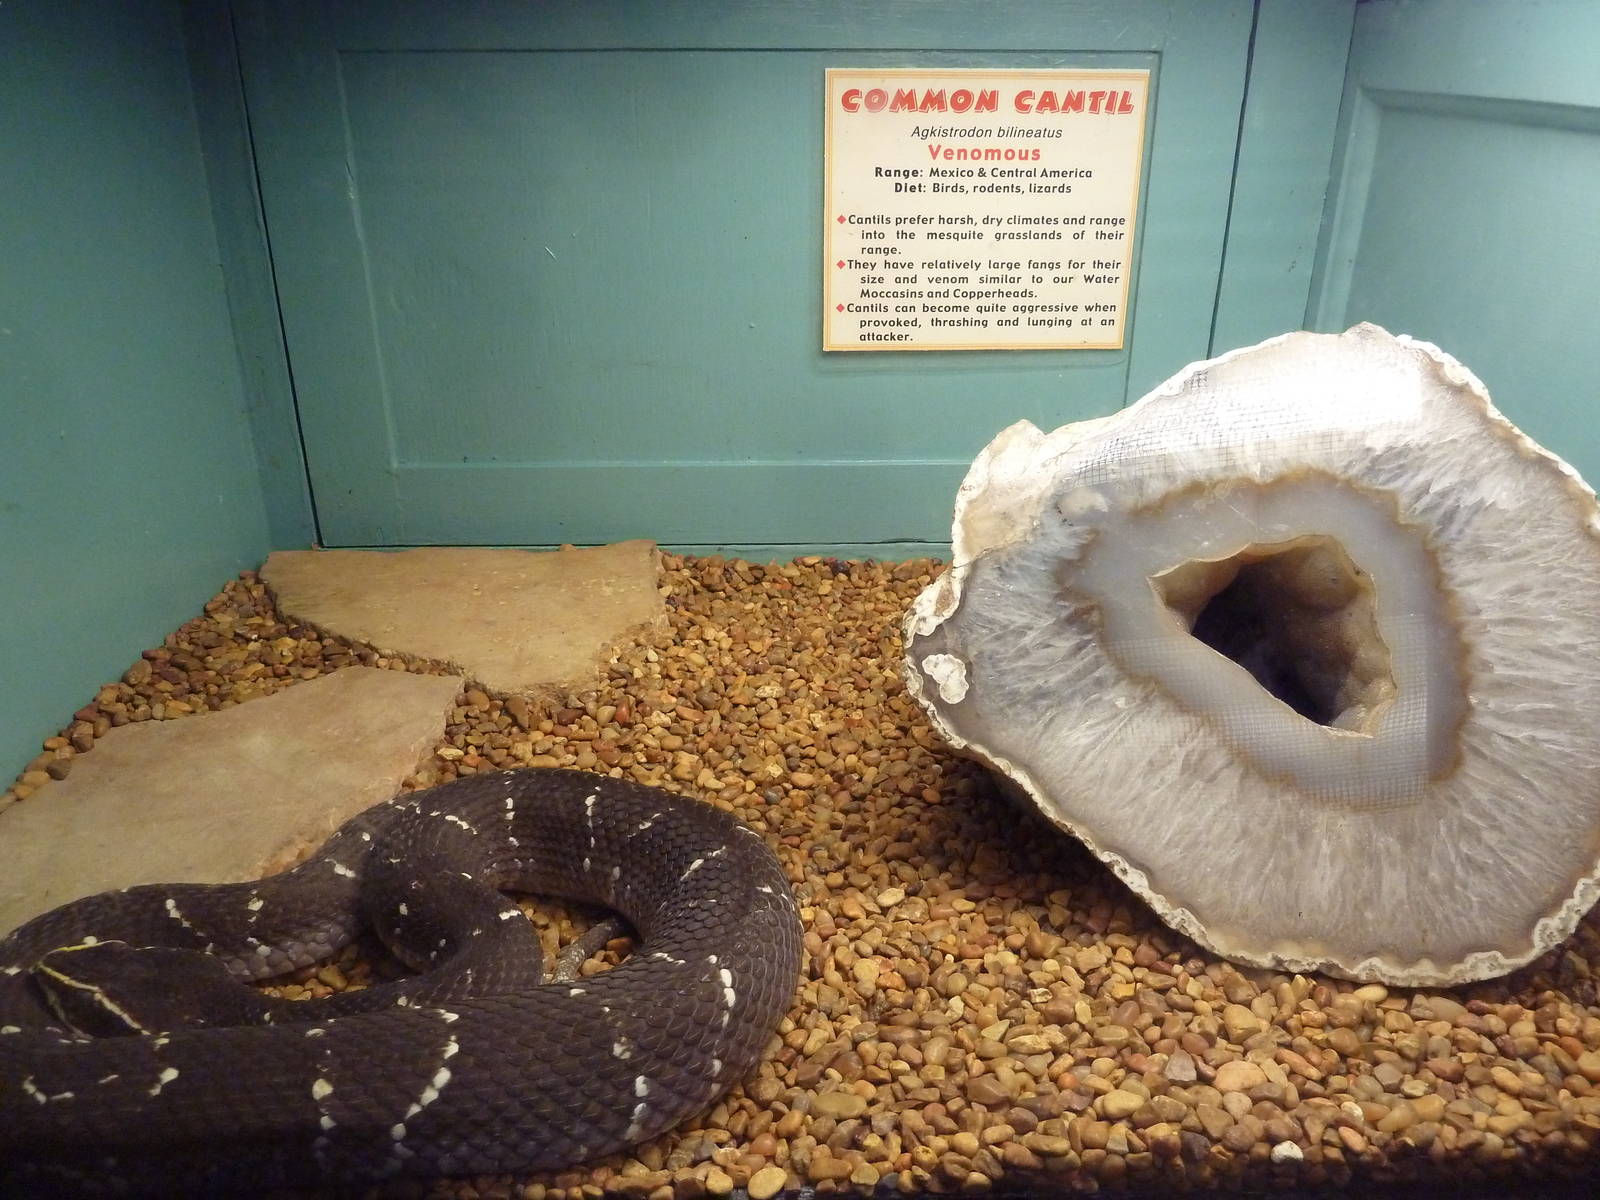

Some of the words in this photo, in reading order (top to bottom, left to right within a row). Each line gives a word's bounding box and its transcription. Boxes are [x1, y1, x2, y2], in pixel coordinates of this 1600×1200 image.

[841, 88, 999, 113] COMMON
[1014, 90, 1134, 115] CANTIL
[910, 126, 992, 140] Agkistrodon
[997, 126, 1062, 138] bilineatus
[928, 144, 1040, 160] Venomous
[875, 167, 923, 179] Range:
[929, 167, 974, 177] Mexico
[978, 167, 987, 177] &
[991, 168, 1036, 177] Central
[1040, 168, 1092, 178] America
[895, 183, 926, 193] Diet:
[933, 183, 968, 194] Birds,
[973, 183, 1024, 195] rodents,
[1029, 183, 1071, 193] lizards
[848, 215, 891, 224] Cantils
[895, 215, 934, 226] prefer
[939, 215, 977, 226] harsh,
[982, 215, 1002, 226] dry
[1007, 215, 1059, 225] climates
[1063, 215, 1085, 225] and
[1090, 218, 1125, 227] range
[862, 230, 885, 239] into
[896, 230, 915, 239] the
[927, 230, 983, 241] mesquite
[995, 230, 1062, 241] grasslands
[1073, 230, 1085, 240] of
[1096, 230, 1124, 240] their
[861, 247, 901, 256] range.
[847, 260, 876, 271] They
[884, 260, 914, 269] have
[922, 260, 981, 271] relatively
[989, 260, 1020, 271] large
[1028, 260, 1061, 271] fangs
[1068, 260, 1085, 269] for
[1093, 260, 1121, 269] their
[860, 275, 884, 284] size
[895, 274, 917, 284] and
[928, 276, 968, 285] venom
[979, 274, 1022, 284] similar
[1032, 274, 1043, 284] to
[1053, 275, 1074, 284] our
[1084, 274, 1120, 284] Water
[860, 288, 923, 298] Moccasins
[927, 289, 949, 298] and
[953, 289, 1037, 300] Copperheads.
[847, 303, 888, 312] Cantils
[895, 305, 915, 313] can
[923, 303, 969, 312] become
[976, 303, 1006, 314] quite
[1013, 303, 1078, 314] aggressive
[1085, 303, 1116, 312] when
[860, 317, 921, 328] provoked,
[931, 317, 988, 328] thrashing
[997, 317, 1019, 326] and
[1028, 317, 1072, 328] lunging
[1081, 317, 1092, 326] at
[1101, 318, 1114, 327] an
[860, 332, 913, 343] attacker.
